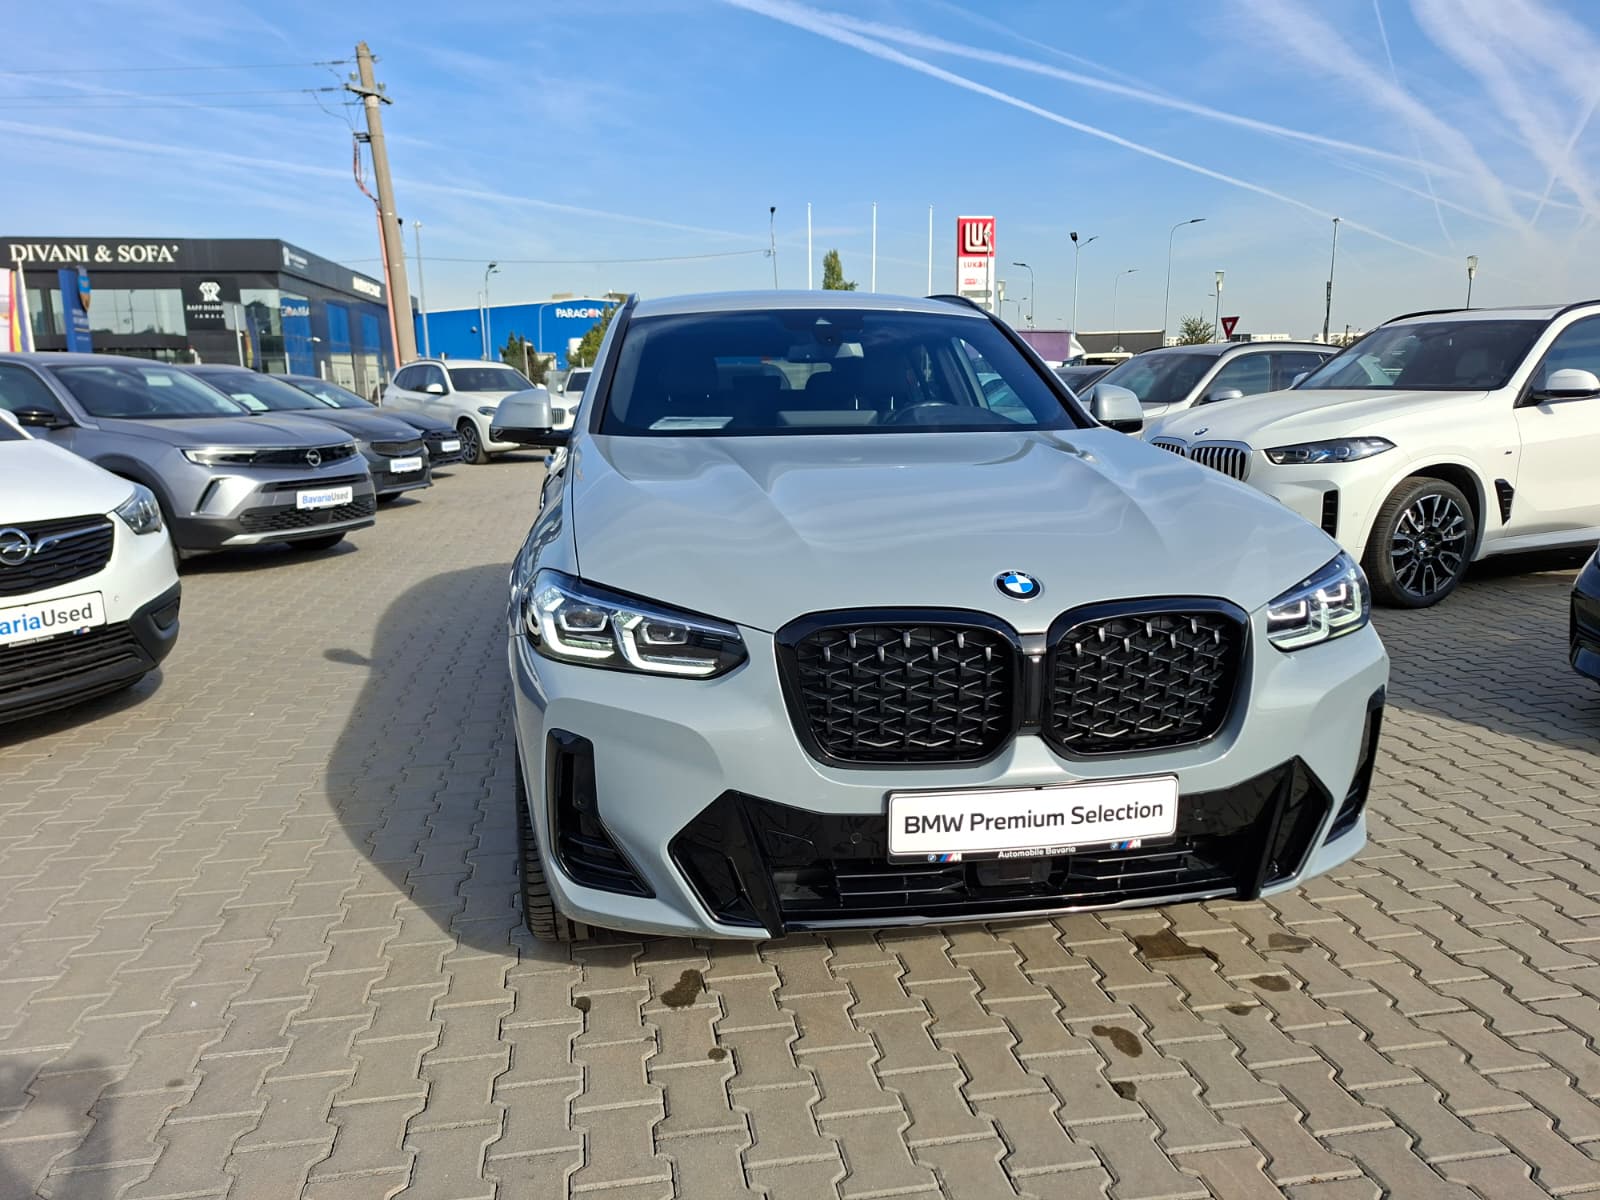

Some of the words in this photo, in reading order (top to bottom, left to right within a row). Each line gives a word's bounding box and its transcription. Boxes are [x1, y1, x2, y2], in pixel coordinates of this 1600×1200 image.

[9, 244, 90, 263] DIVANI
[94, 245, 113, 262] &
[555, 308, 603, 318] PARAGON
[302, 491, 349, 504] BavariaUsed
[904, 813, 964, 834] BMW
[969, 809, 1065, 832] Premium
[1070, 801, 1164, 825] Selection
[997, 847, 1044, 859] Automobile
[1045, 845, 1076, 856] Bavaria
